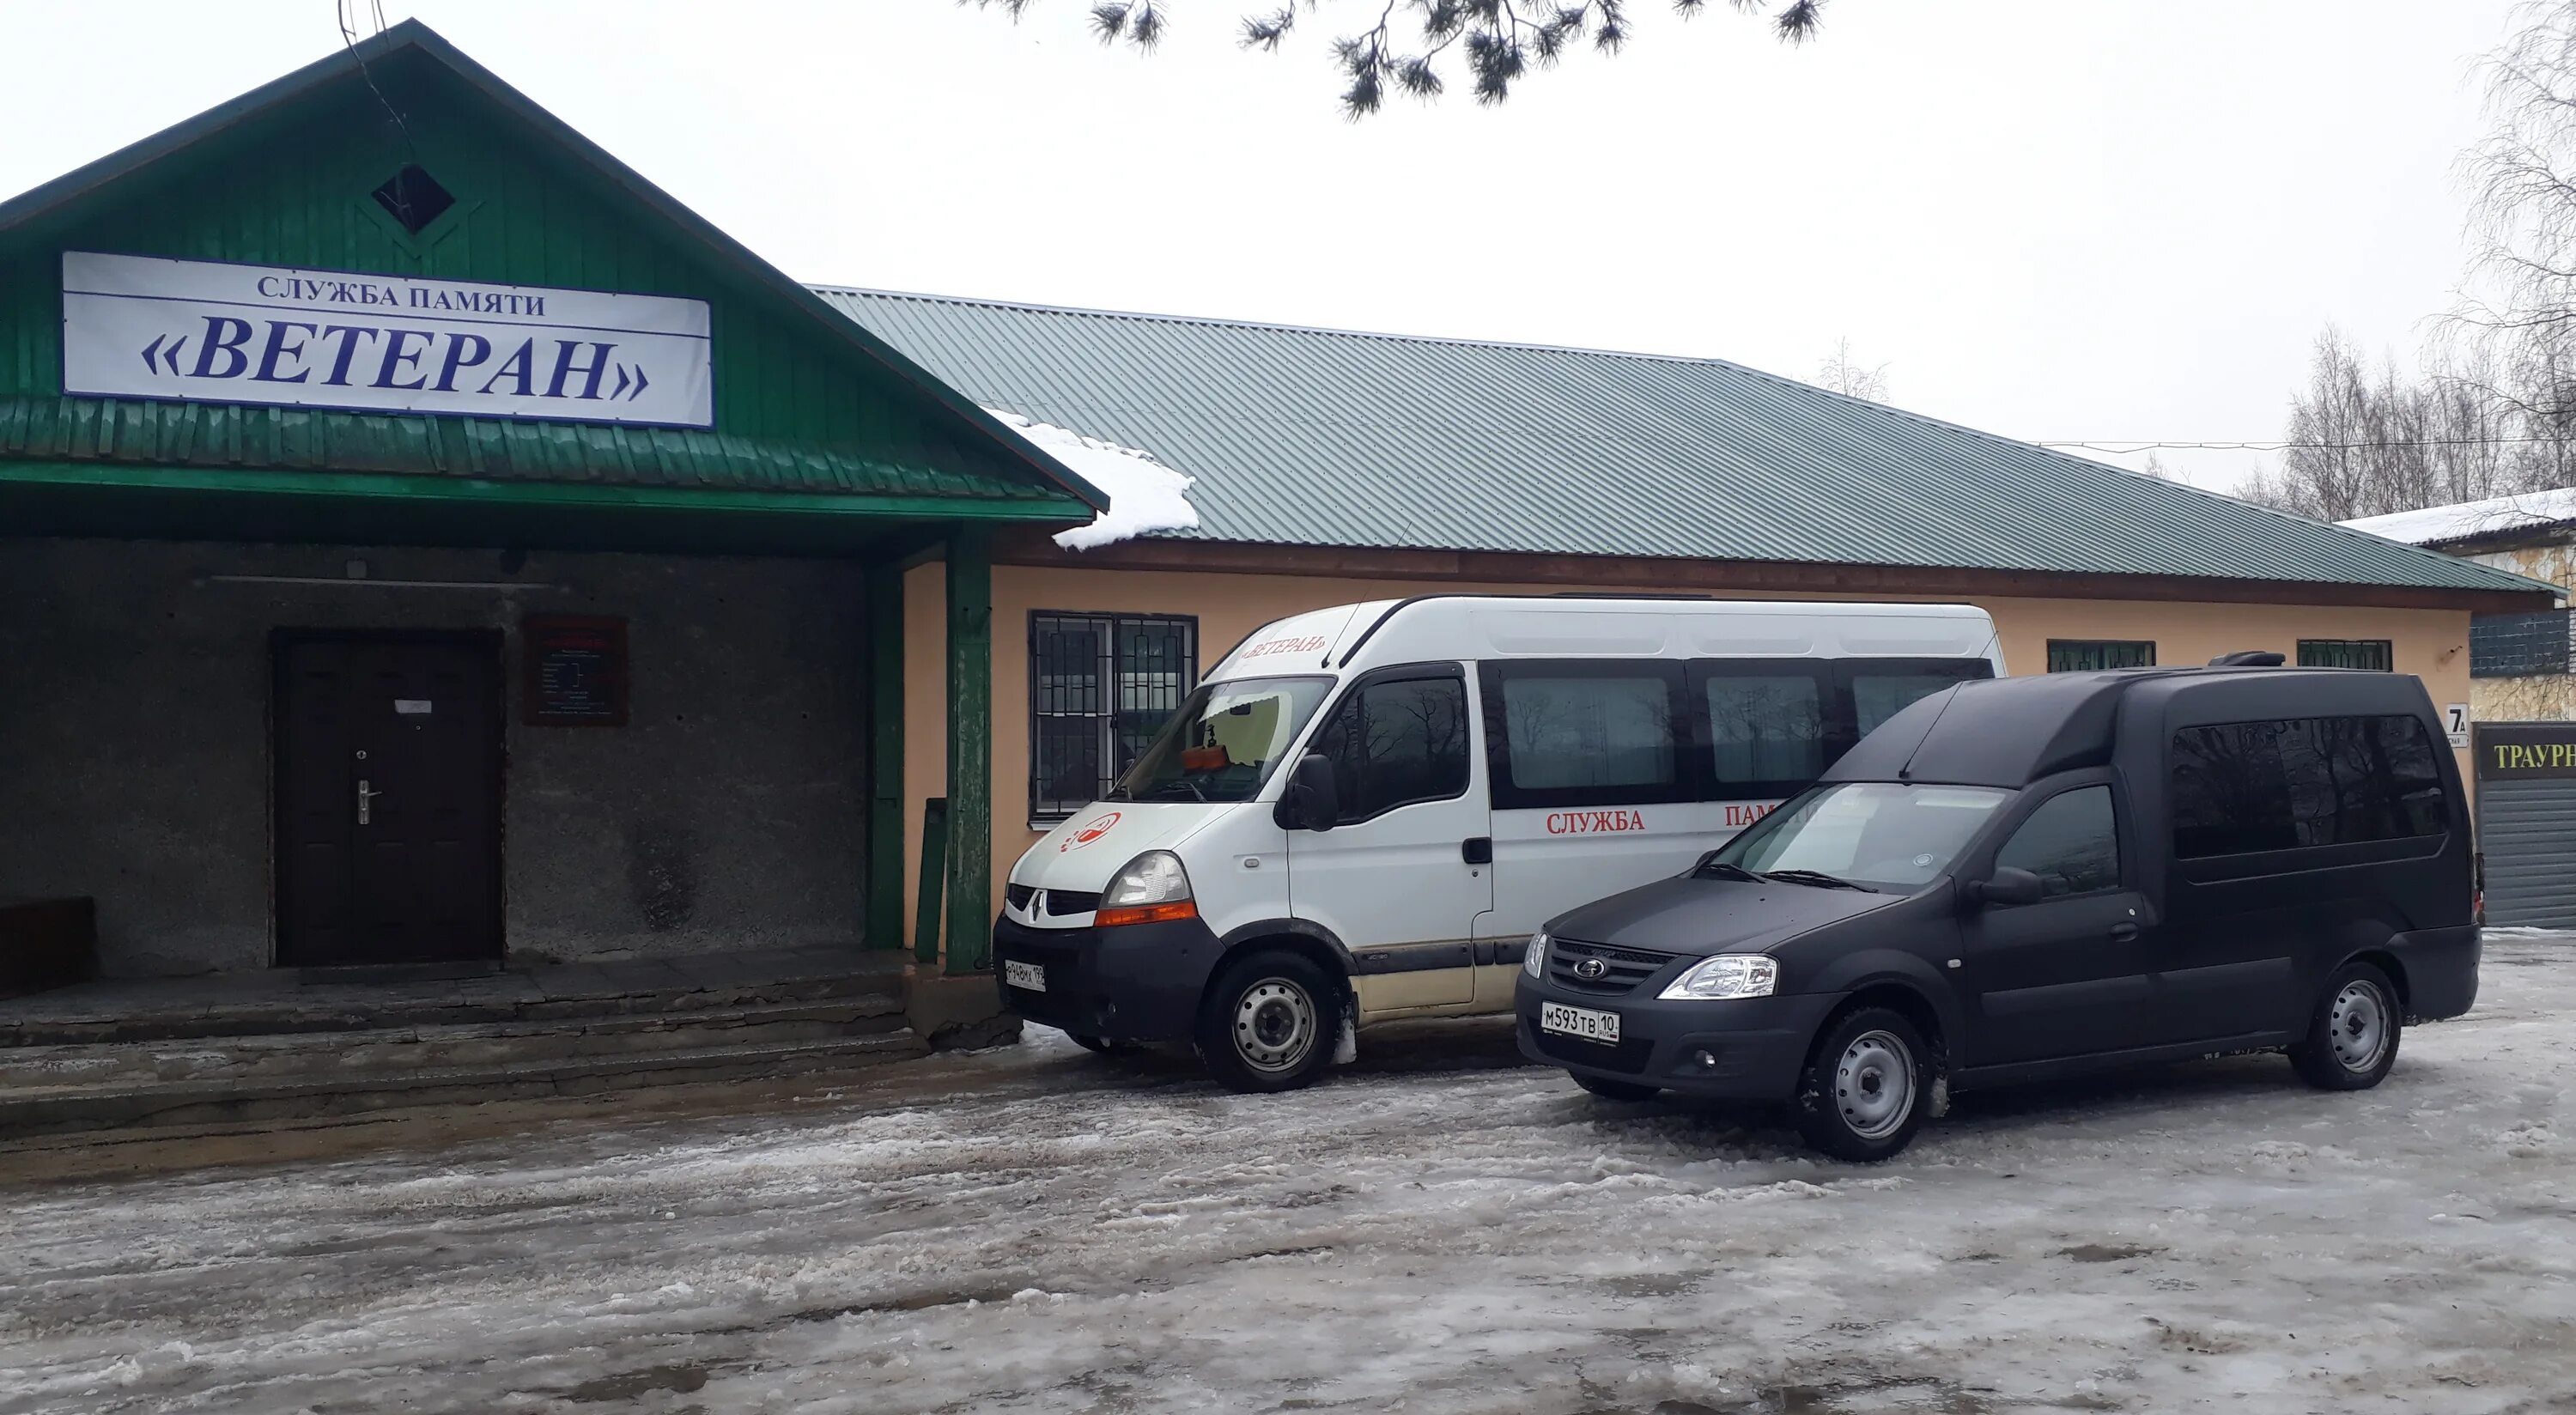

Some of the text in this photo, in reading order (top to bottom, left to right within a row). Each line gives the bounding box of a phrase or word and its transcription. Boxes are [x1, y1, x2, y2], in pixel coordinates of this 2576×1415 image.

[257, 275, 546, 317] СЛУЖБА ПАМЯТИ
[141, 316, 649, 402] «ВЕТЕРАН»
[1242, 636, 1325, 659] «ВЕТЕРАН»
[1546, 811, 1645, 835] СЛУЖБА
[1546, 1007, 1614, 1033] М593ТВ 10
[1599, 1029, 1610, 1038] RUS
